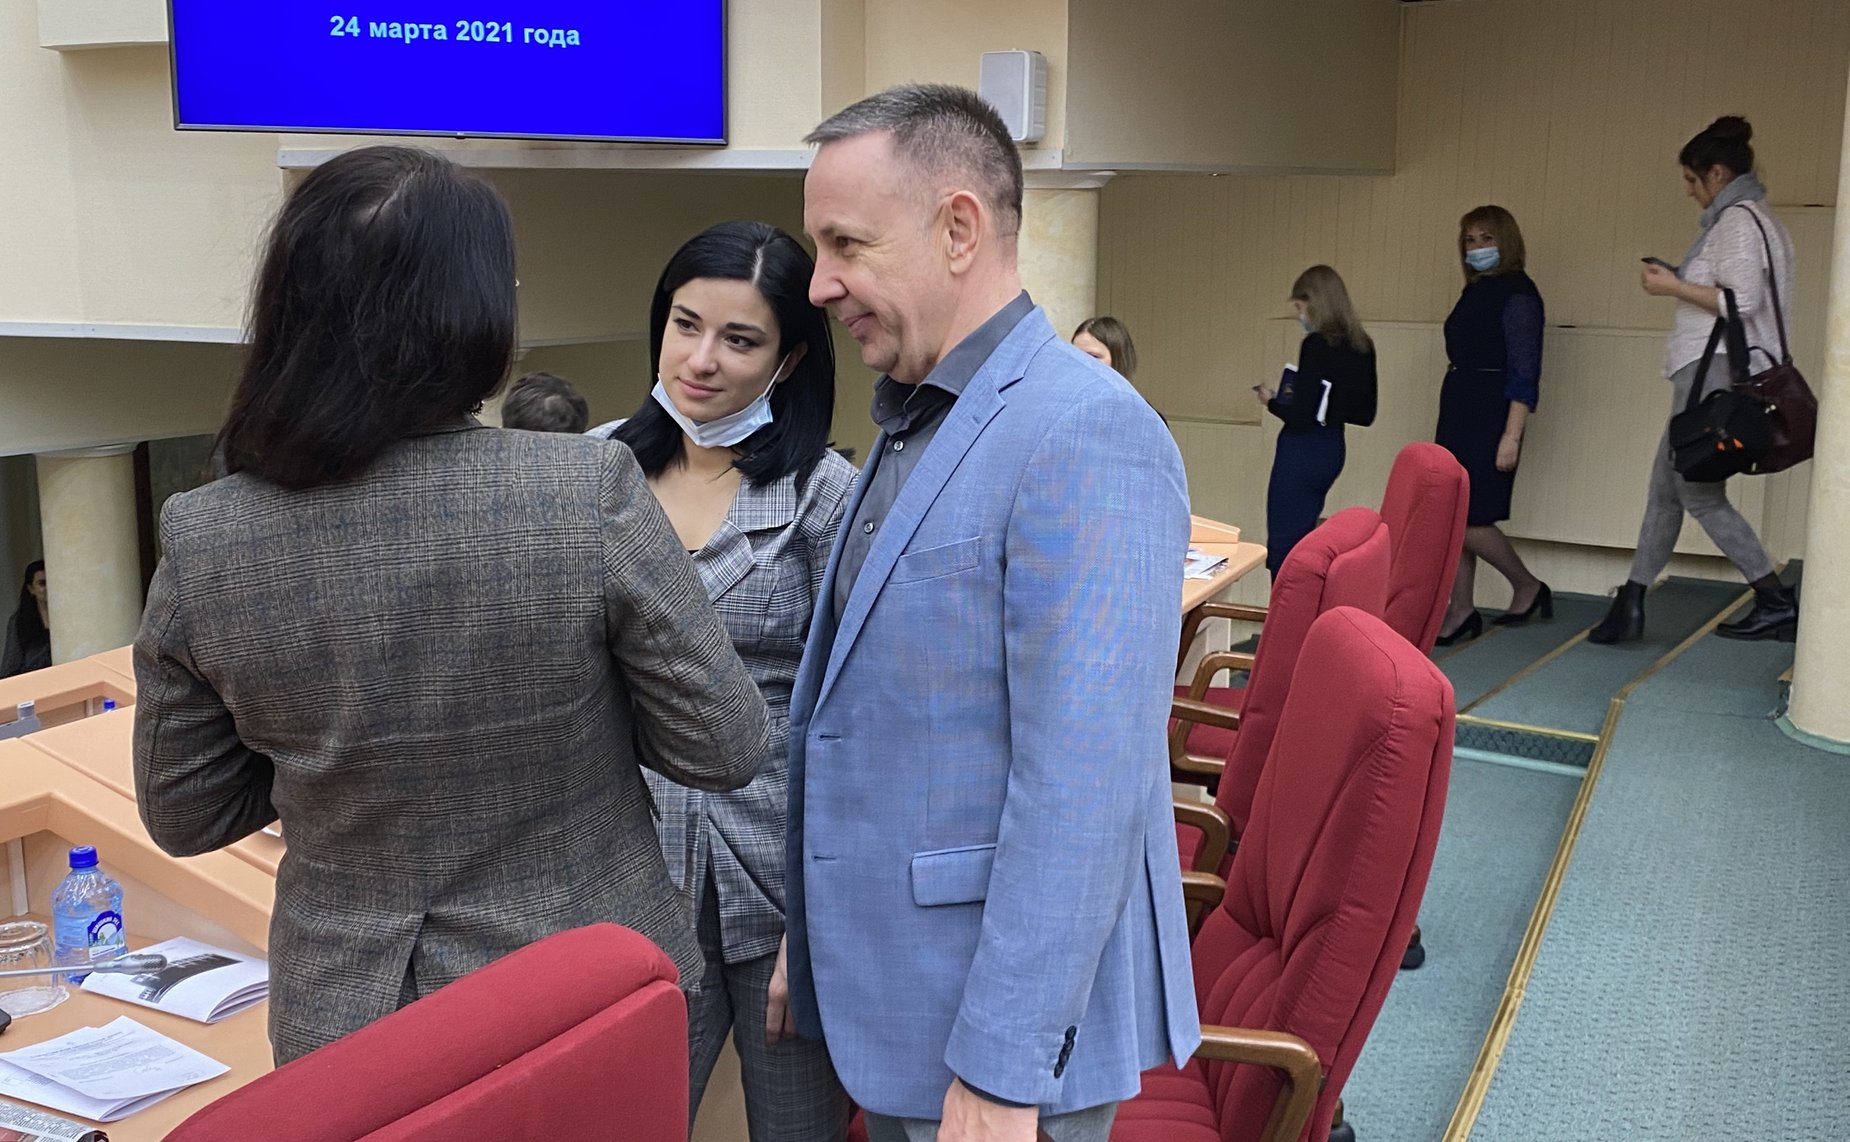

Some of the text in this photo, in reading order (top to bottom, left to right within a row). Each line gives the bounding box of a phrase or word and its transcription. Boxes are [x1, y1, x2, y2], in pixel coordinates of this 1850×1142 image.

[330, 16, 580, 48] 24 марта 2021 года
